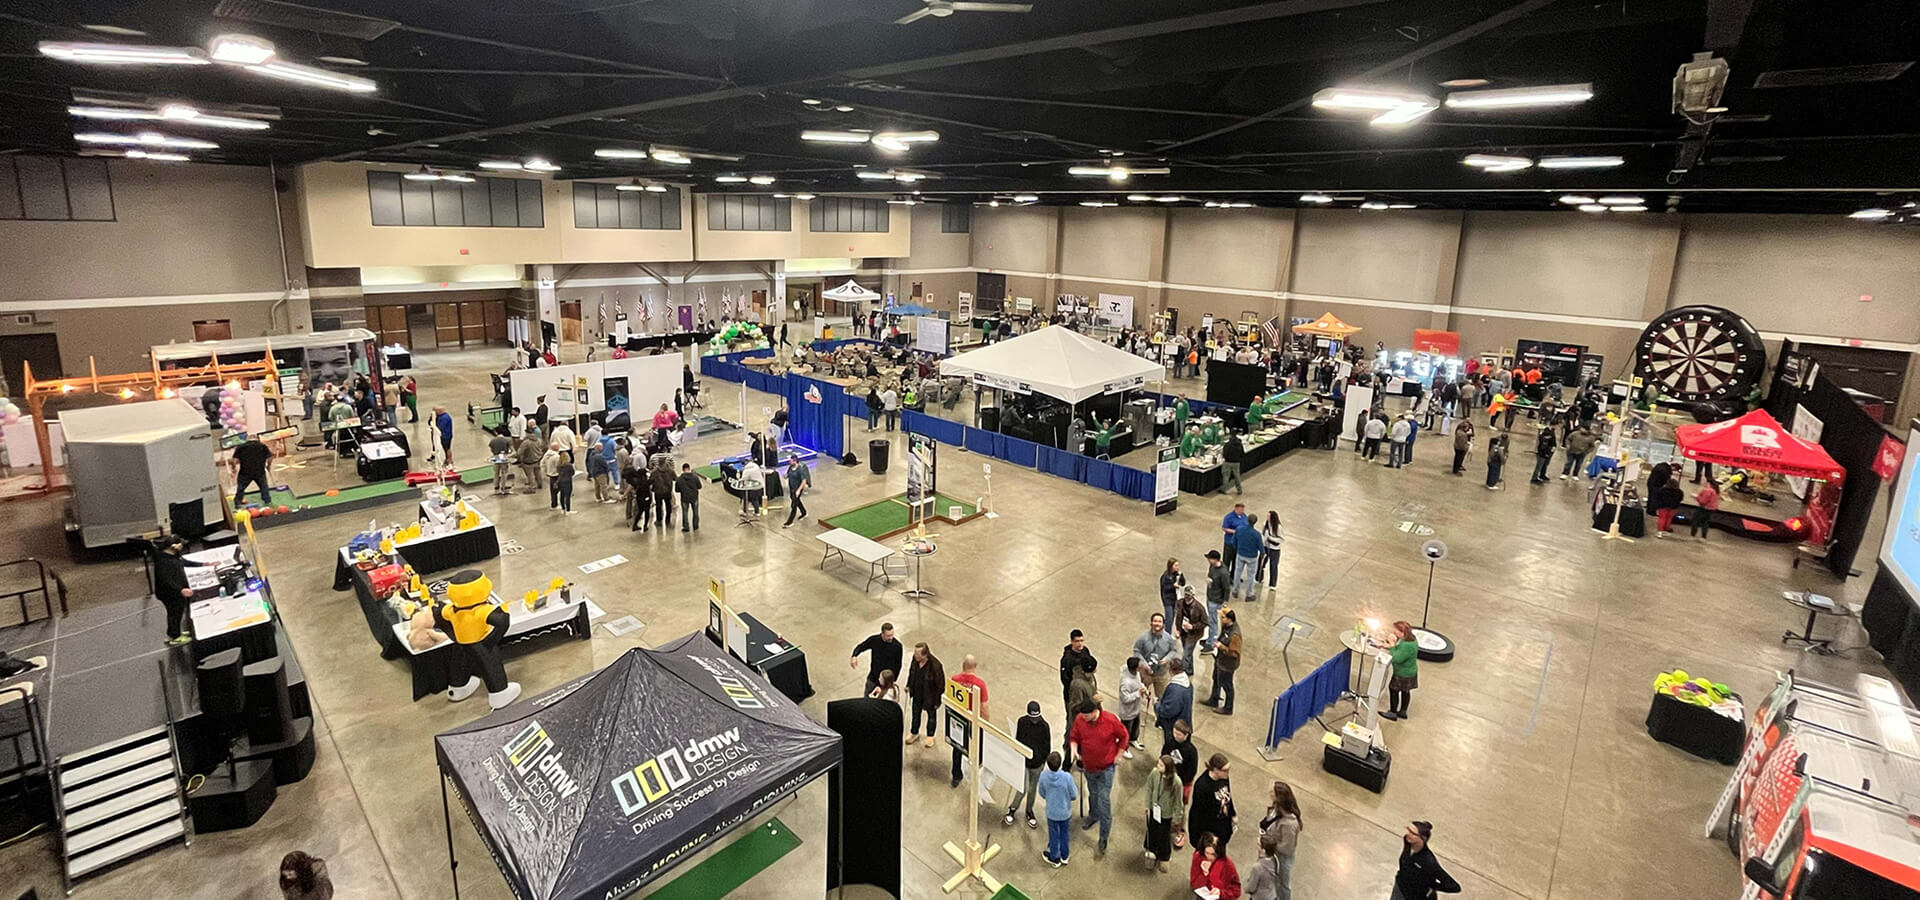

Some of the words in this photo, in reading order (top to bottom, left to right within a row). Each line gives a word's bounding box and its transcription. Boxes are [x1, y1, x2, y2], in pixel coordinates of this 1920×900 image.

[950, 685, 964, 703] 16
[683, 726, 741, 763] dmw
[693, 743, 749, 777] DESIGN
[482, 756, 499, 782] Driving
[494, 774, 513, 802] Success
[508, 795, 519, 811] by
[514, 805, 536, 834] Design
[524, 770, 560, 814] DESIGN
[539, 751, 579, 799] dmw
[632, 808, 674, 835] Driving
[674, 786, 714, 811] Success
[713, 775, 728, 788] by
[726, 760, 761, 780] Design
